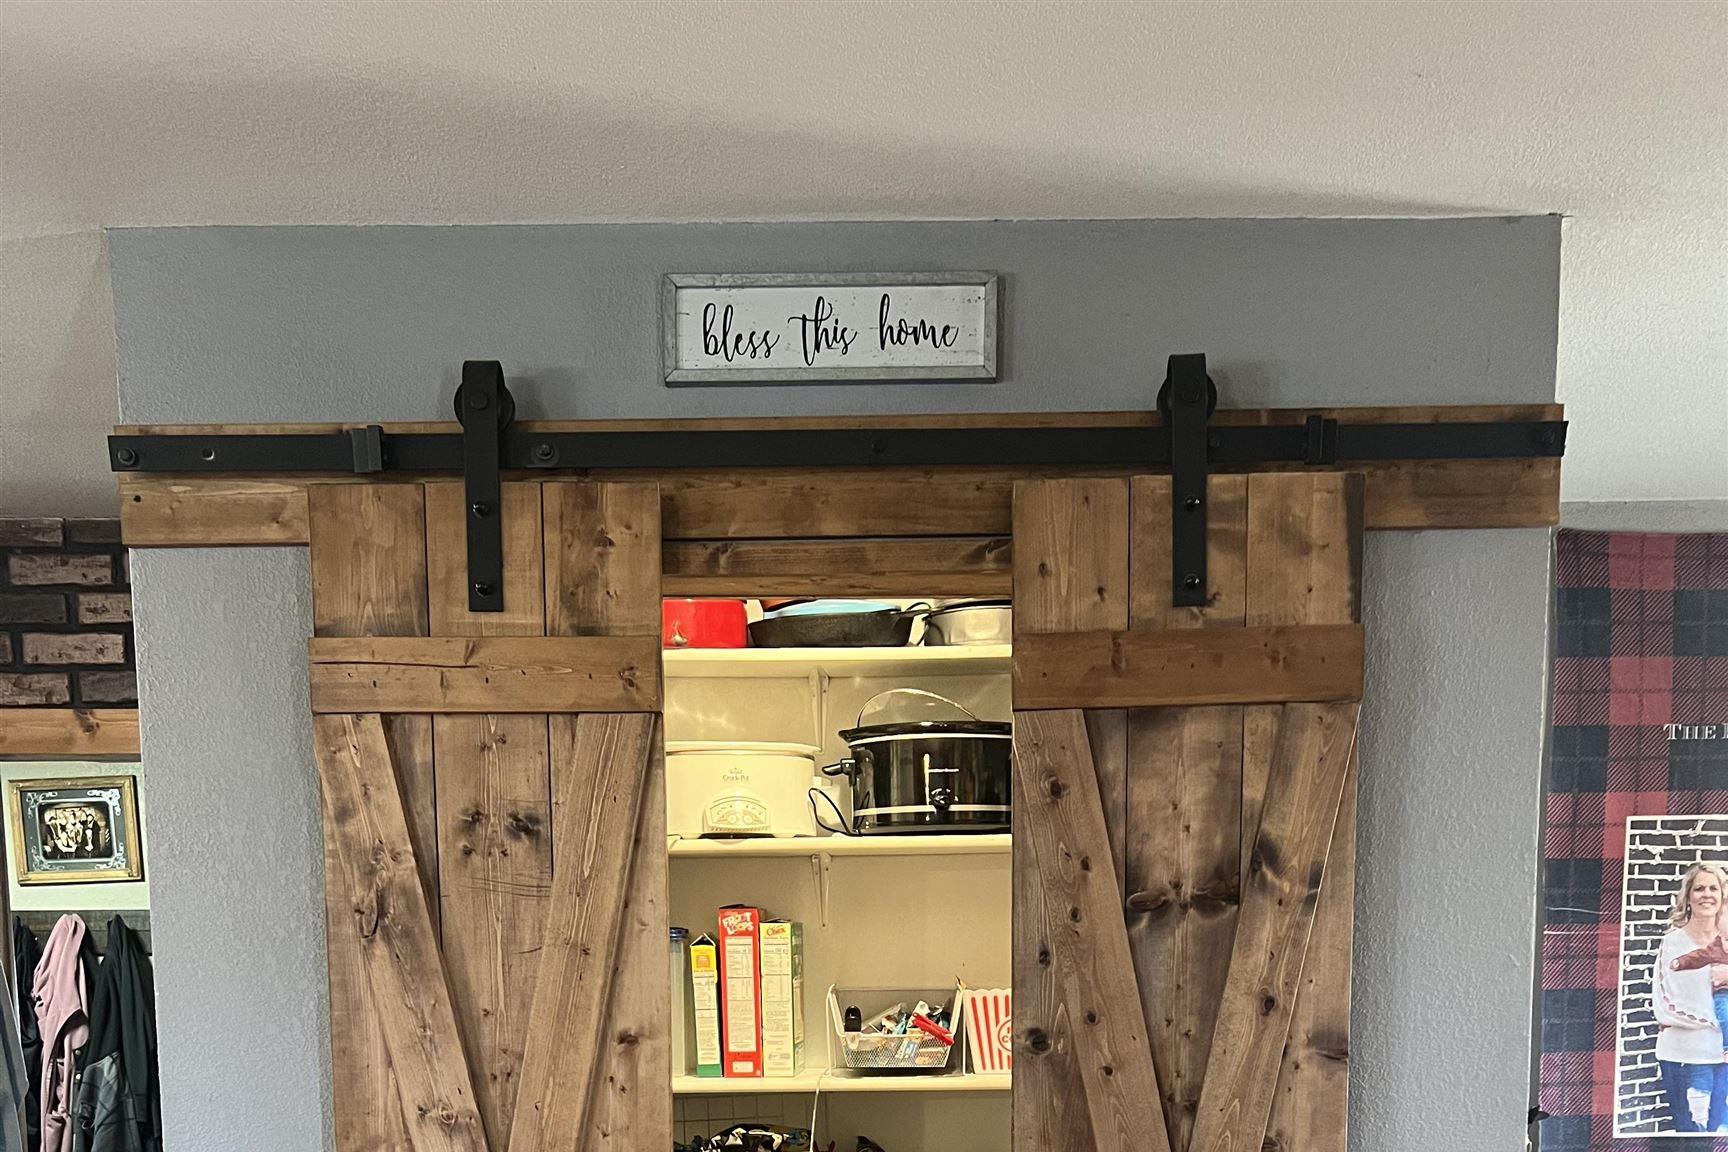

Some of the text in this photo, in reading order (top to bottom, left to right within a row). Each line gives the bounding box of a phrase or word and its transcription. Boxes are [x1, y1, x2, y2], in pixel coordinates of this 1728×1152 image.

[703, 293, 959, 366] bless this home
